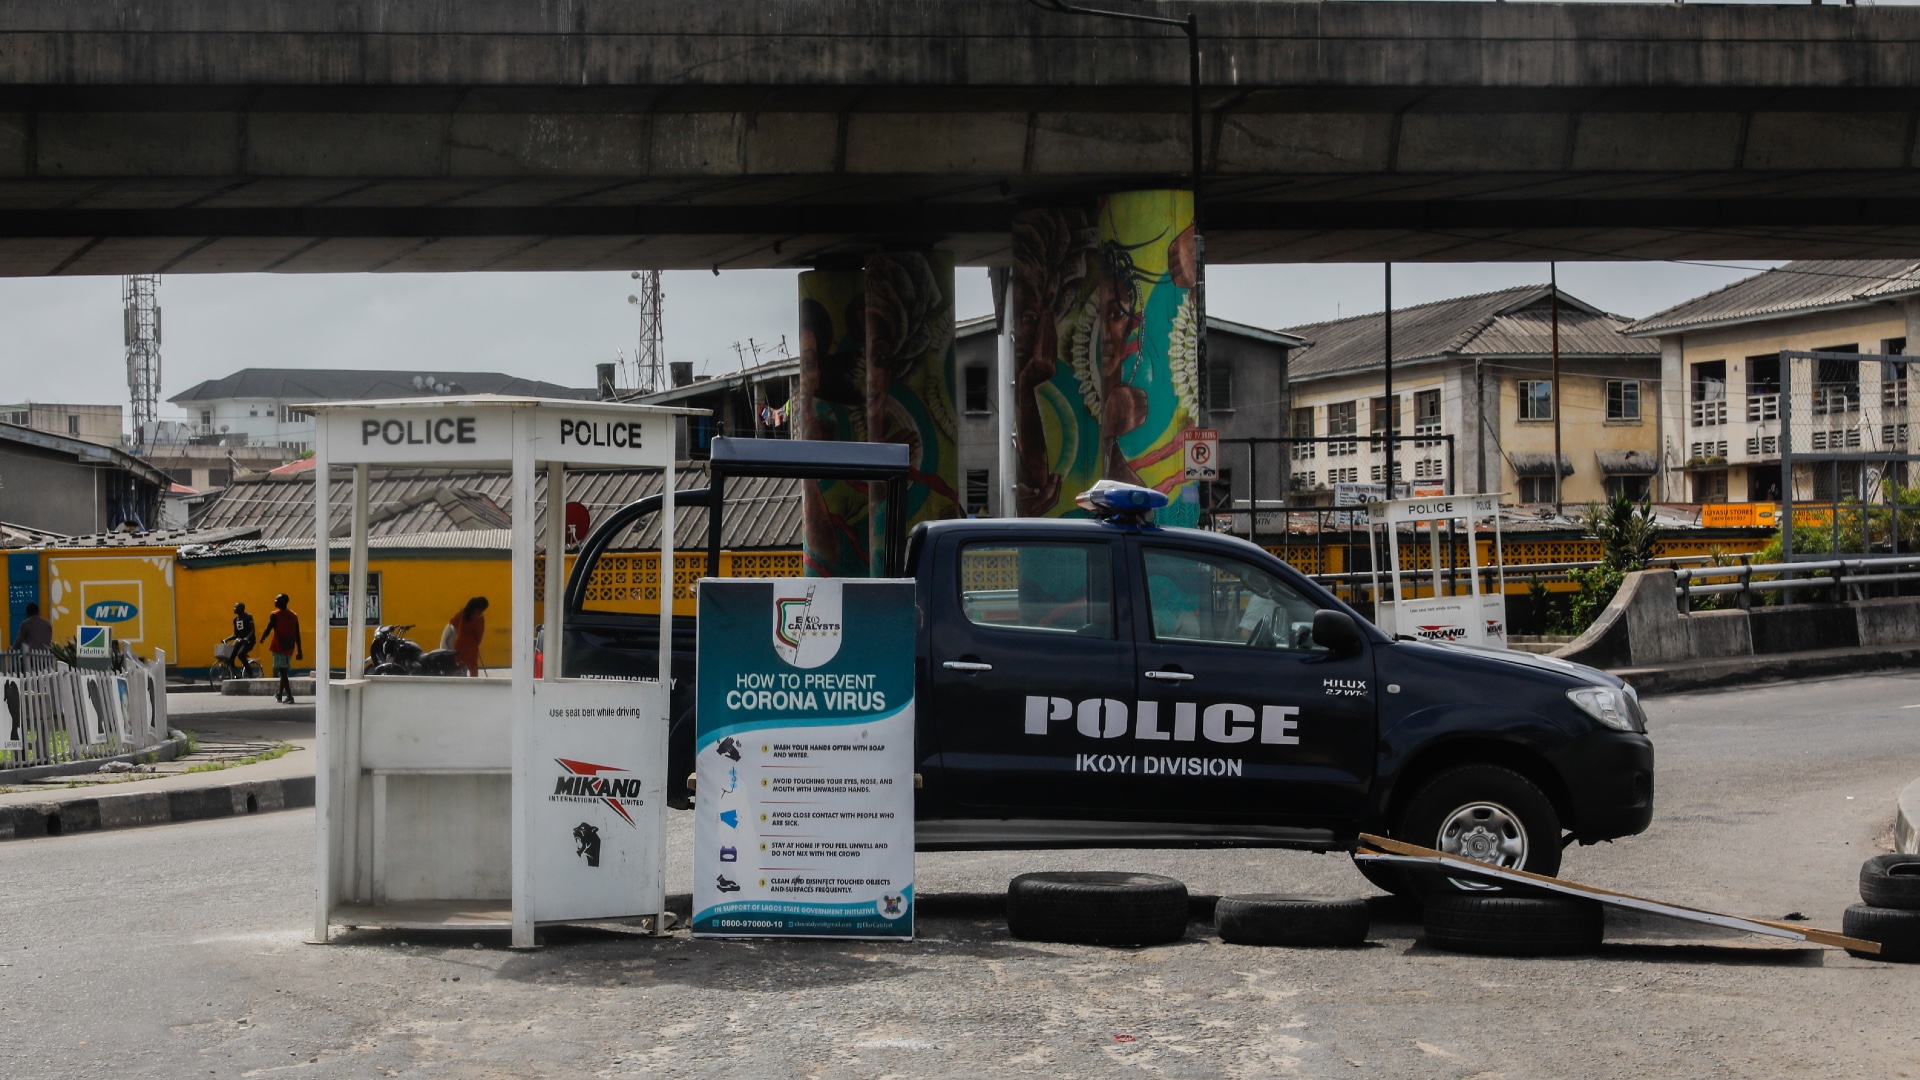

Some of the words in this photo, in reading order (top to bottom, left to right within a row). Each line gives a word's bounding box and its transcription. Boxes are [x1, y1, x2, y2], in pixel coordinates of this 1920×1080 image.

[362, 418, 476, 445] POLICE
[561, 420, 641, 448] POLICE
[1195, 431, 1216, 439] PARKING
[1408, 502, 1453, 514] POLICE
[1477, 501, 1492, 511] POLICE
[95, 606, 128, 618] MTN
[80, 648, 104, 656] Fidelity
[737, 674, 774, 689] HOW
[779, 674, 800, 689] TO
[805, 674, 876, 689] PREVENT
[1324, 679, 1366, 689] HILUX
[727, 690, 818, 710] CORONA
[824, 692, 885, 711] VIRUS
[550, 708, 563, 717] Use
[566, 708, 580, 717] seat
[597, 707, 614, 716] while
[617, 706, 640, 718] driving
[1025, 696, 1299, 744] POLICE
[1076, 754, 1135, 773] IKOYI
[1144, 756, 1242, 776] DIVISION
[554, 776, 641, 798] MIKANO
[549, 795, 599, 804] INTERNATIONAL
